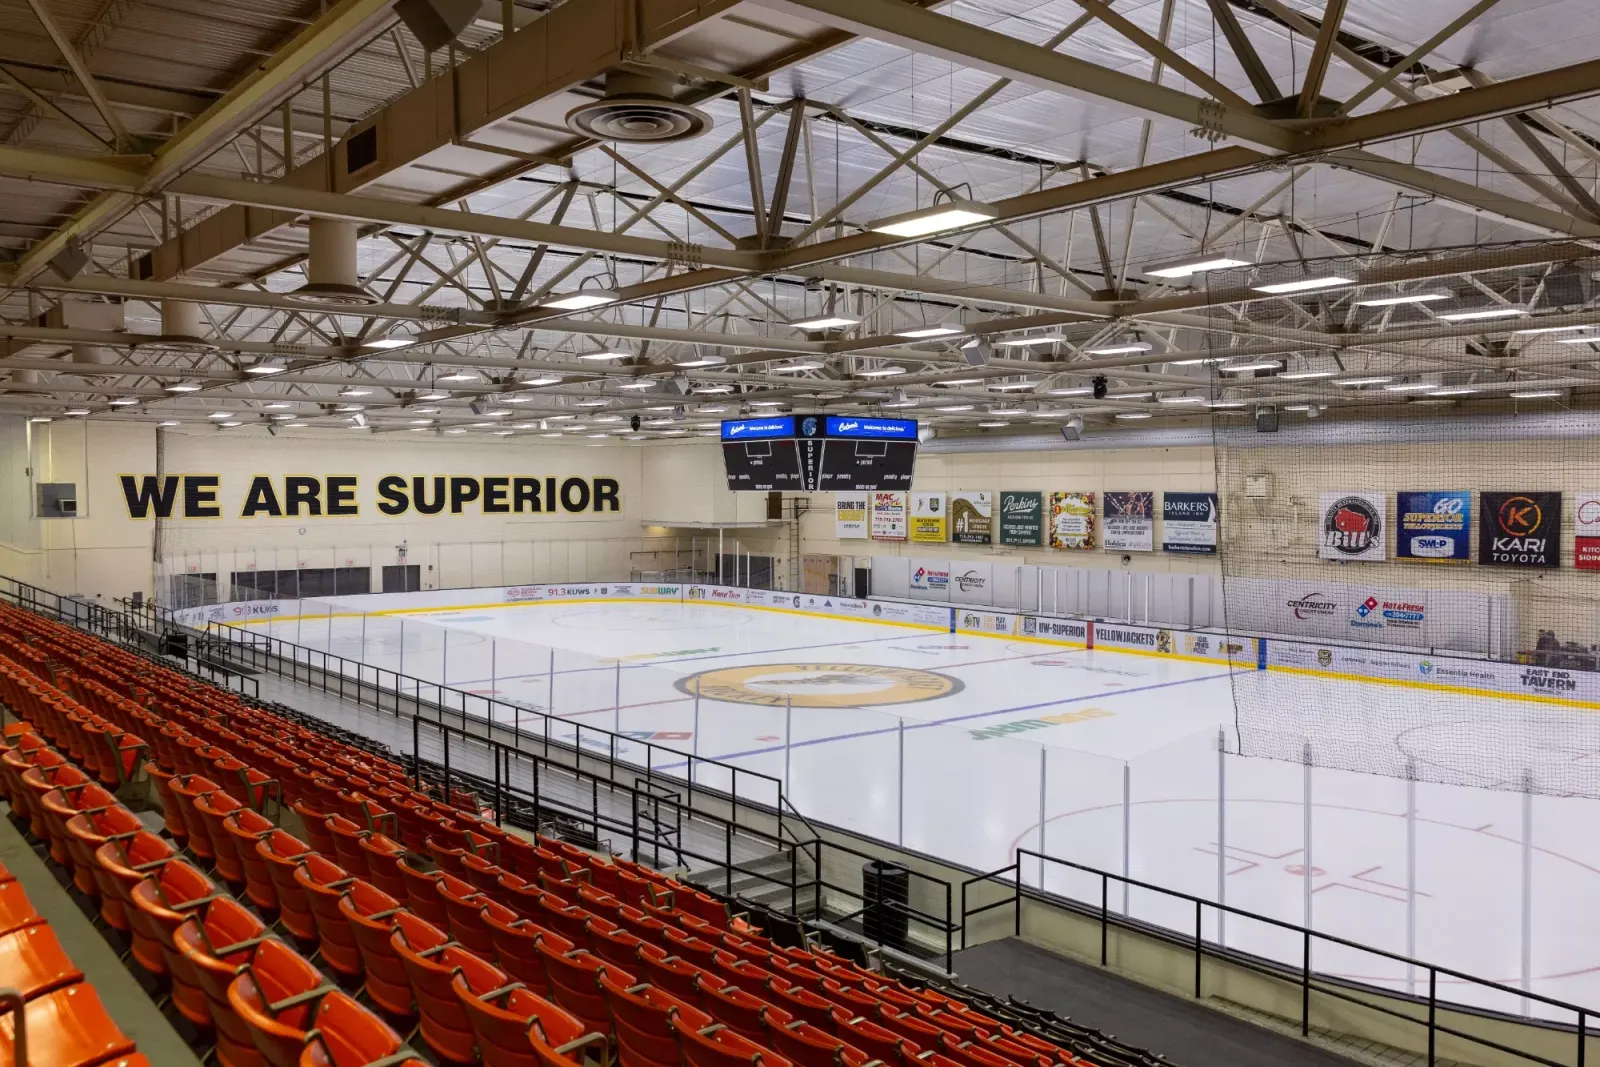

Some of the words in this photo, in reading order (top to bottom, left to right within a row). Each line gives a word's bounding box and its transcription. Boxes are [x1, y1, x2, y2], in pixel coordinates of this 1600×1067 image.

[117, 473, 222, 520] WE
[239, 473, 359, 519] ARE
[376, 474, 623, 516] SUPERIOR
[875, 493, 894, 501] MAC
[837, 501, 854, 510] BRING
[855, 501, 866, 510] THE
[1003, 495, 1039, 513] Perkins
[1164, 501, 1209, 512] BARKERS
[956, 511, 968, 533] #1
[1403, 512, 1464, 523] SUPERIOR
[1324, 530, 1381, 549] Bill's
[1492, 537, 1546, 553] KARI
[1492, 553, 1545, 563] TOYOTA
[955, 576, 986, 584] CENTRICITY
[548, 588, 566, 596] 91.3
[640, 587, 679, 595] SUBWAY
[1286, 600, 1337, 610] CENTRICITY
[1350, 620, 1383, 629] Domino's
[1038, 622, 1085, 638] UW-SUPERIOR
[1095, 628, 1155, 646] YELLOWJACKETS
[1436, 667, 1468, 677] Essentia
[1469, 670, 1495, 680] Health
[1526, 668, 1549, 677] EAST
[1552, 670, 1570, 679] END
[1520, 675, 1576, 691] TAVERN
